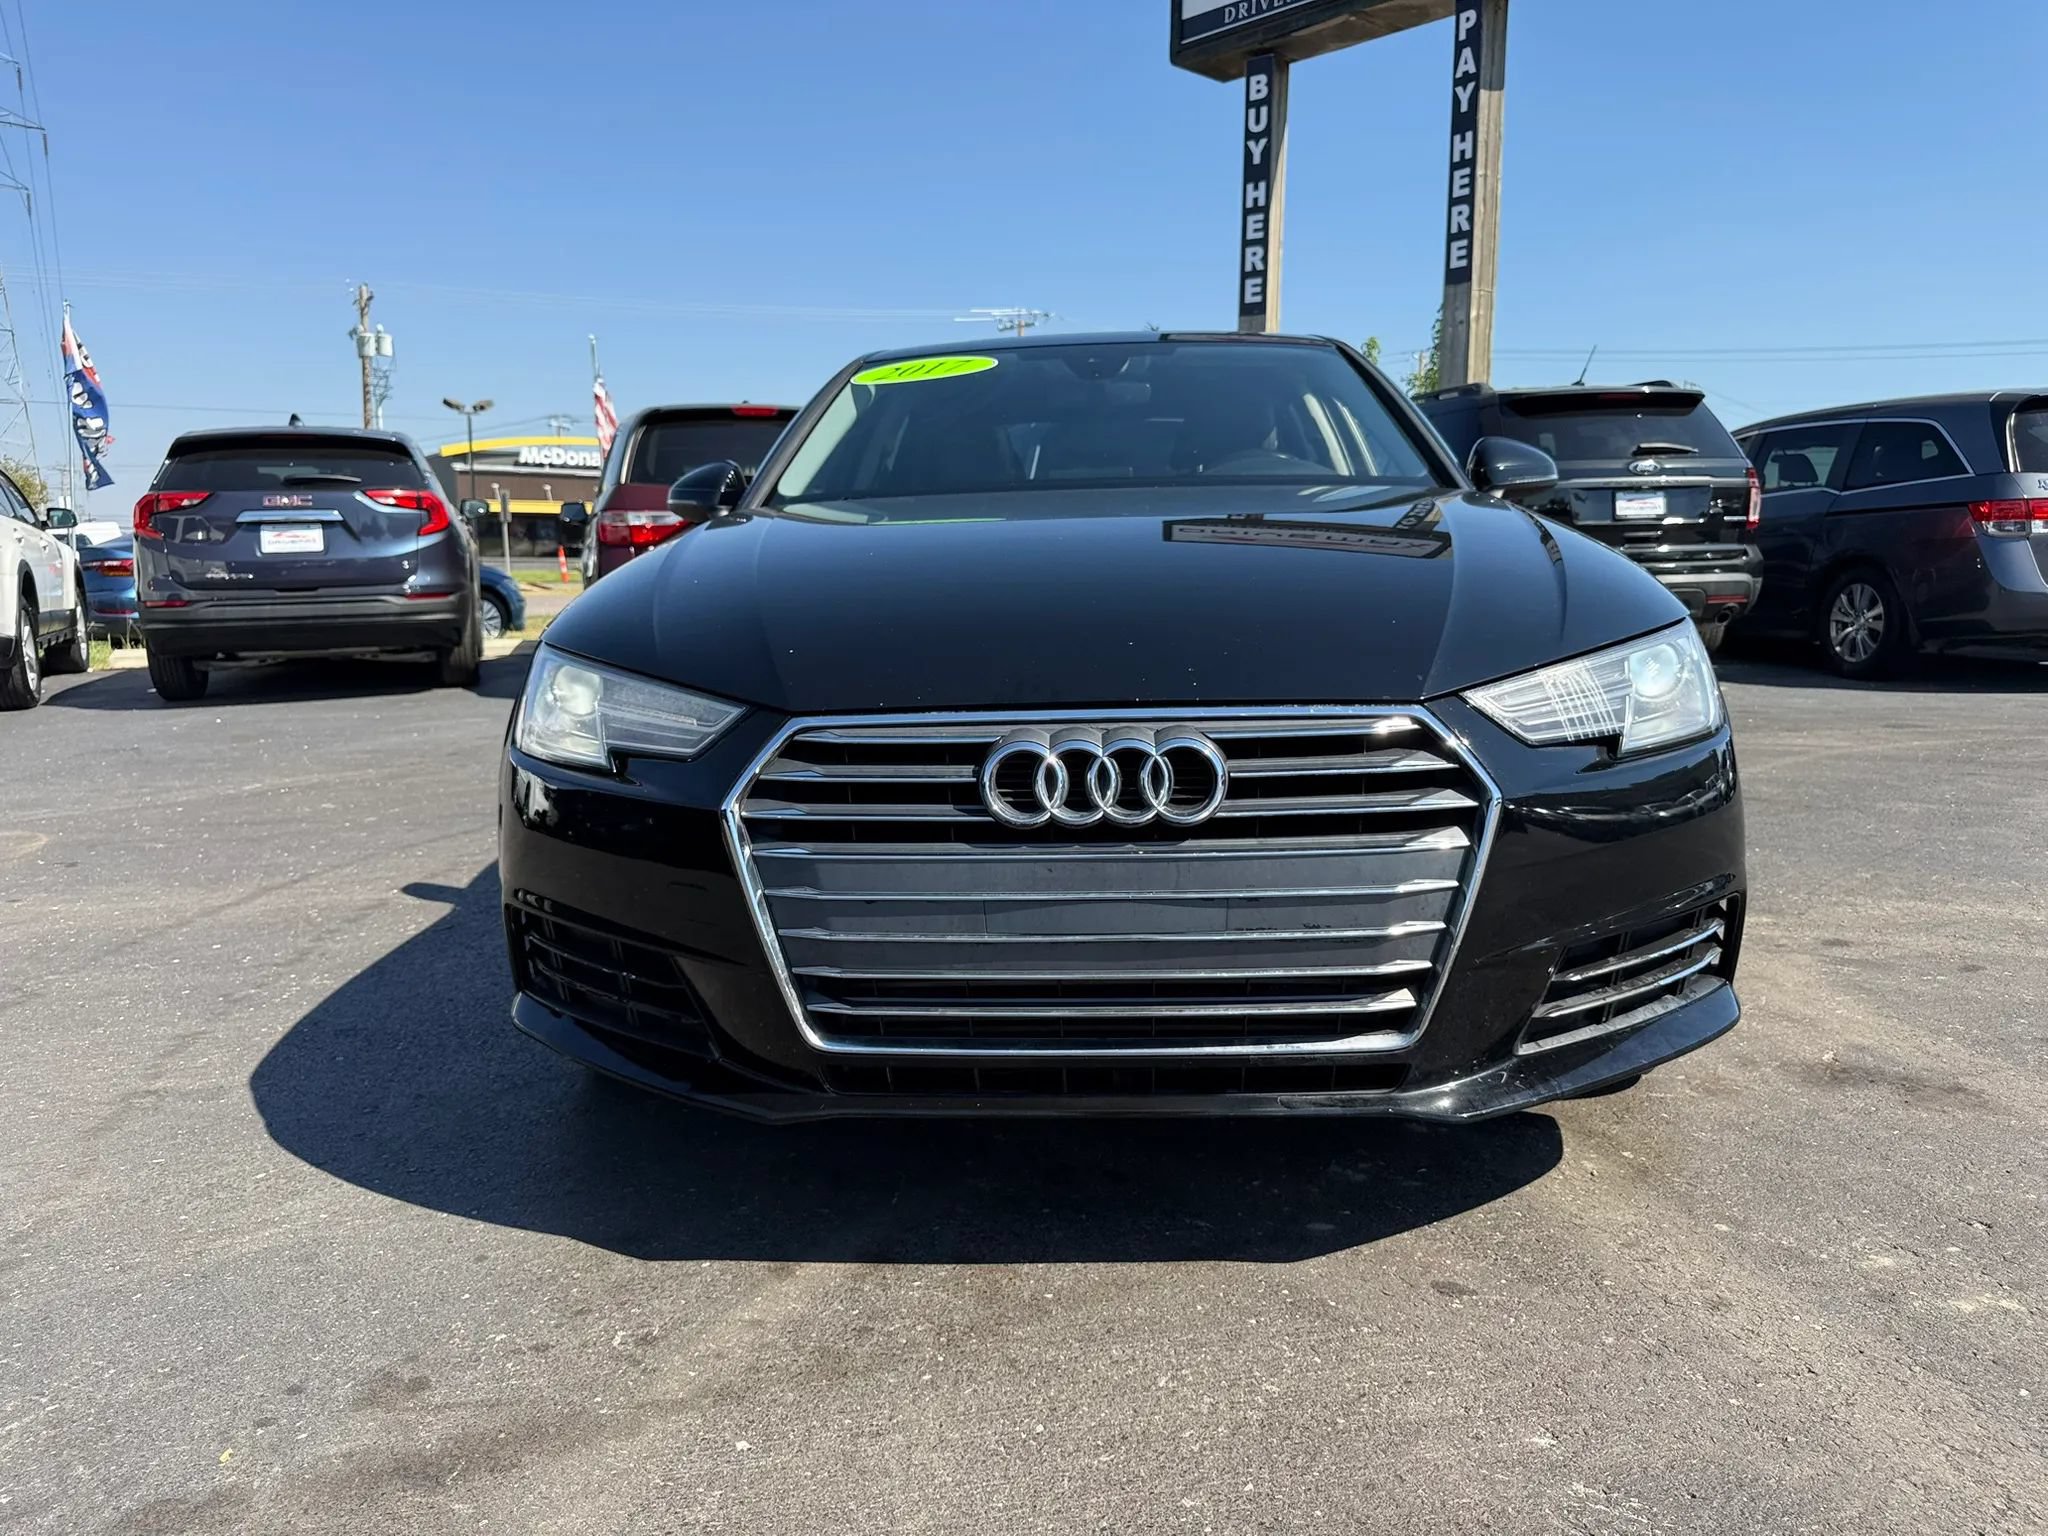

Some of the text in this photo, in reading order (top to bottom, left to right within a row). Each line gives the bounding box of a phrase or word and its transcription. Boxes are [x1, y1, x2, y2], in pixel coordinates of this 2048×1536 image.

[1244, 74, 1268, 304] BUY HERE
[1450, 9, 1477, 270] PAY HERE
[262, 495, 312, 506] GMC
